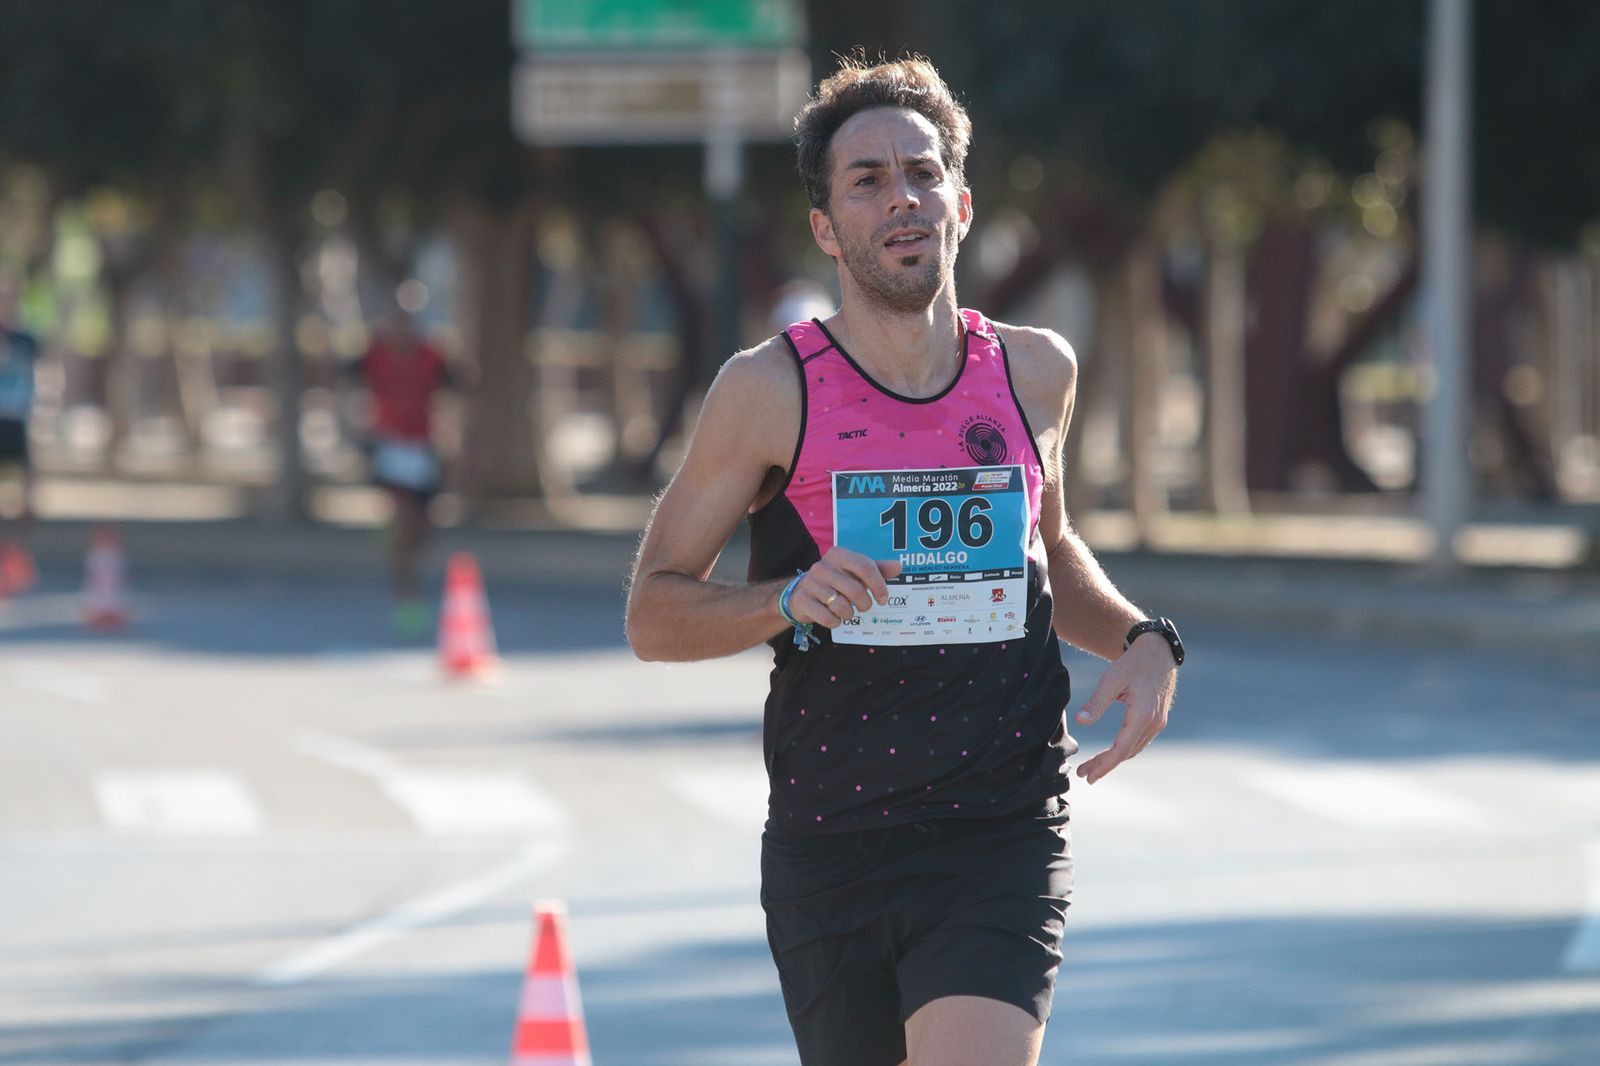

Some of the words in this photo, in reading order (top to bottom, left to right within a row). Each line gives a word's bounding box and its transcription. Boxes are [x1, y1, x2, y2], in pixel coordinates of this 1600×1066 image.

[958, 416, 974, 438] DULCE
[976, 414, 1006, 433] ALIANZA
[838, 429, 868, 440] TACTIC
[892, 475, 920, 483] Medio
[922, 473, 959, 482] Maratón
[892, 483, 931, 493] Almería
[932, 481, 958, 491] 2022
[879, 495, 995, 552] 196
[899, 551, 968, 565] HIDALGO
[887, 595, 910, 606] CDX
